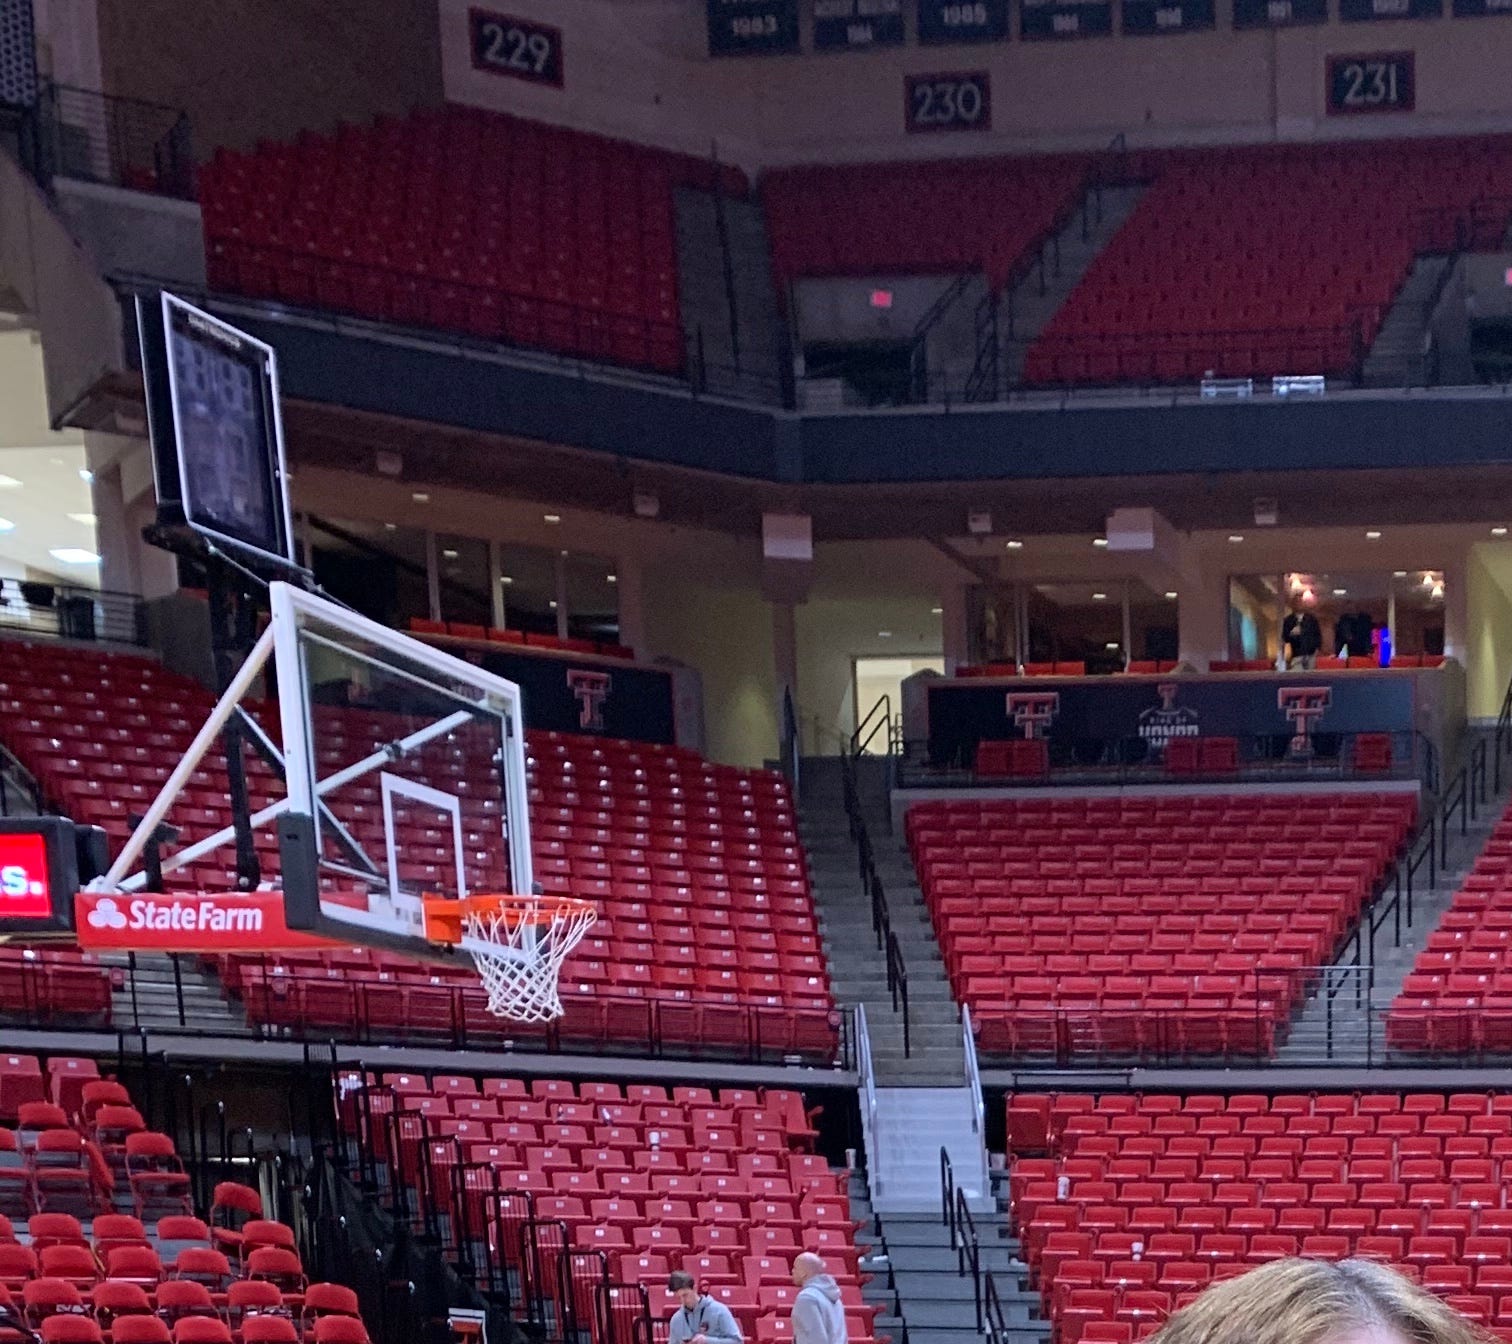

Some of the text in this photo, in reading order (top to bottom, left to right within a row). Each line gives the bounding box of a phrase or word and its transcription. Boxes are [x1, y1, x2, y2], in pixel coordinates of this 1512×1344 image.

[482, 22, 552, 74] 229
[914, 82, 983, 124] 230
[1342, 63, 1399, 106] 231
